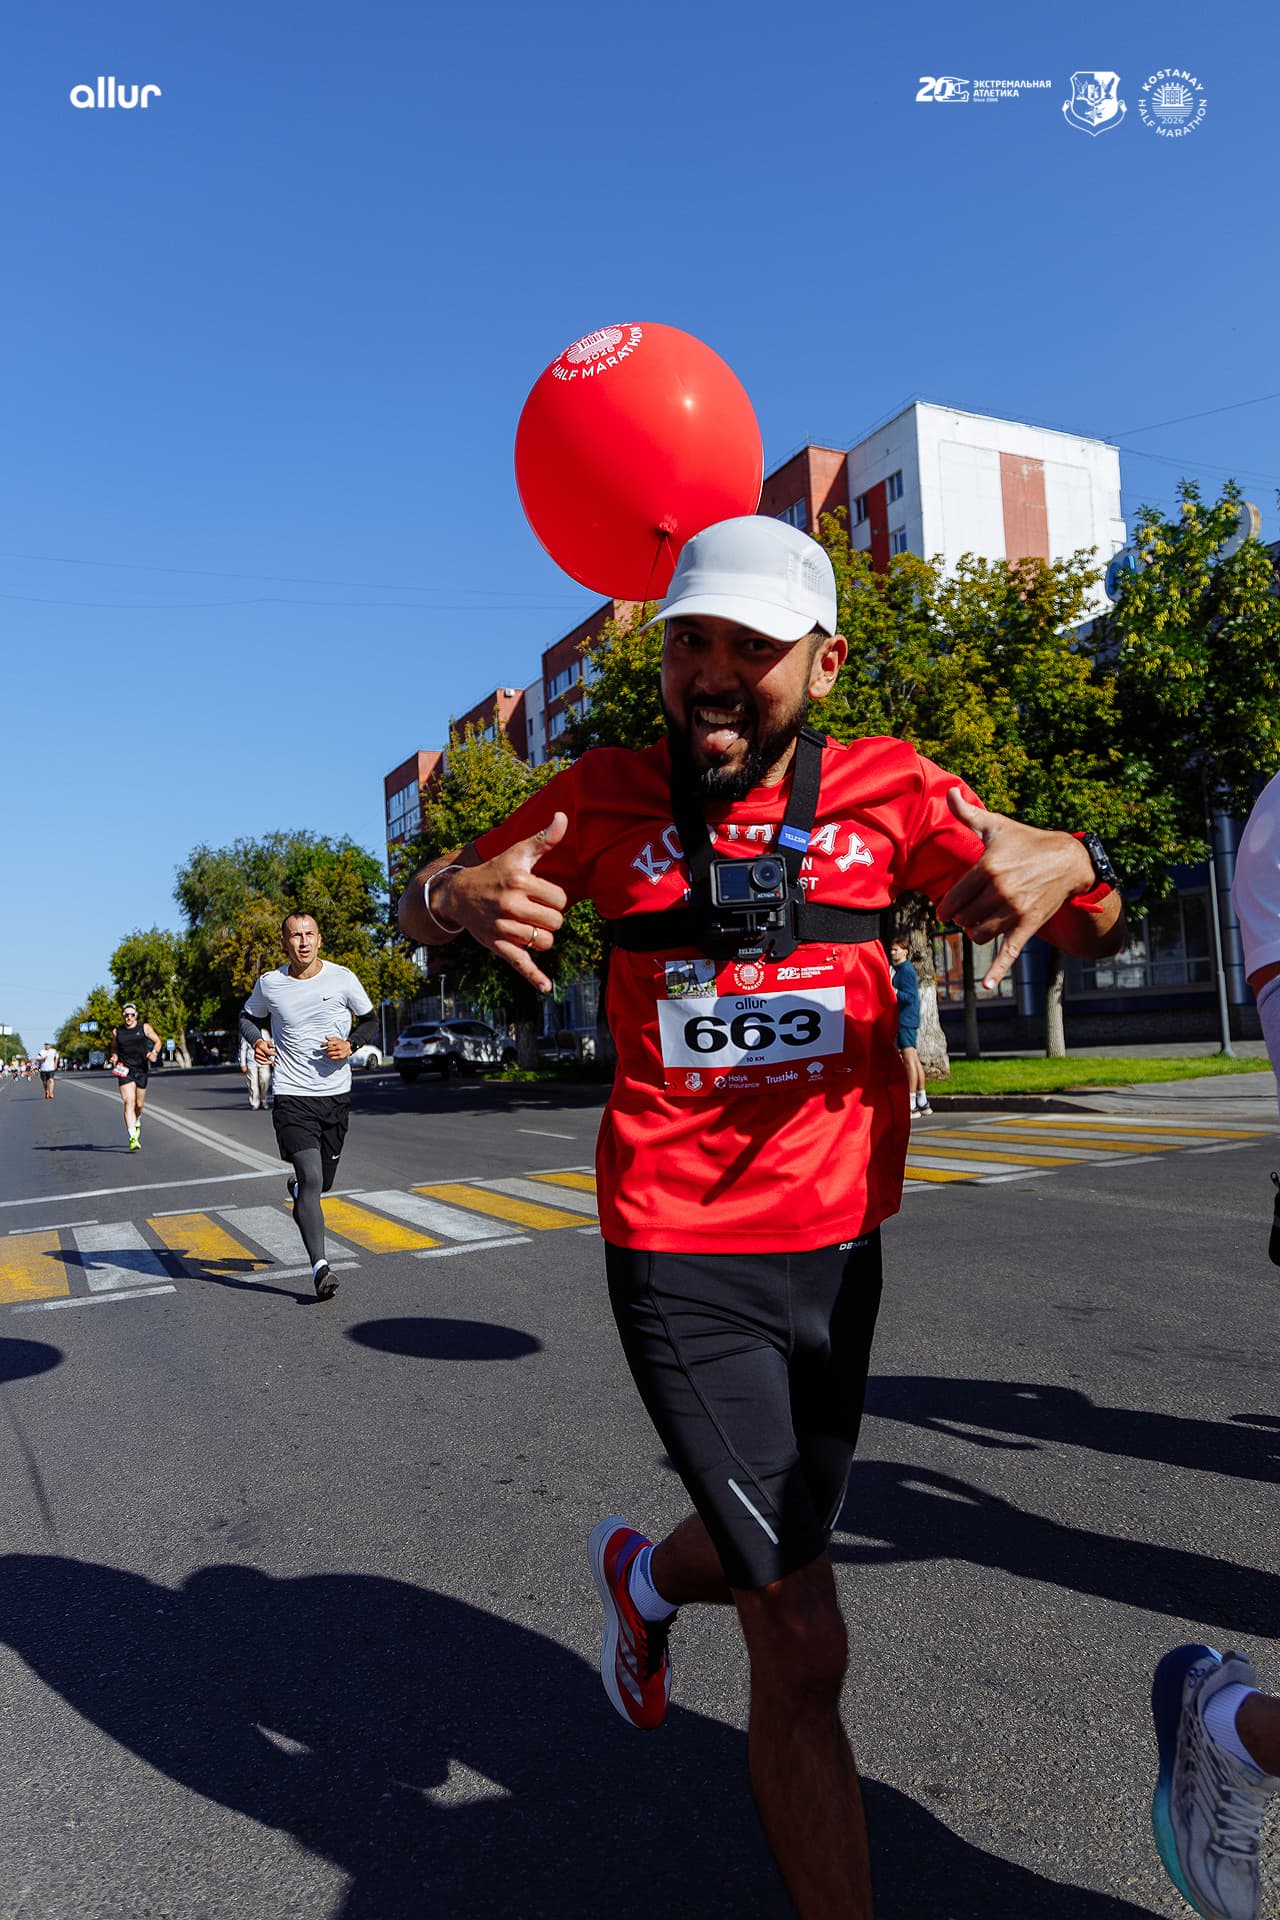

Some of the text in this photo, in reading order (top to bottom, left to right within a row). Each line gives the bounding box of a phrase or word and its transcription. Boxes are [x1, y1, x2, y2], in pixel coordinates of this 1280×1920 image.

[551, 326, 643, 381] HALF MARATHON
[585, 344, 616, 366] 2026
[735, 998, 767, 1010] allur
[684, 1008, 822, 1054] 663
